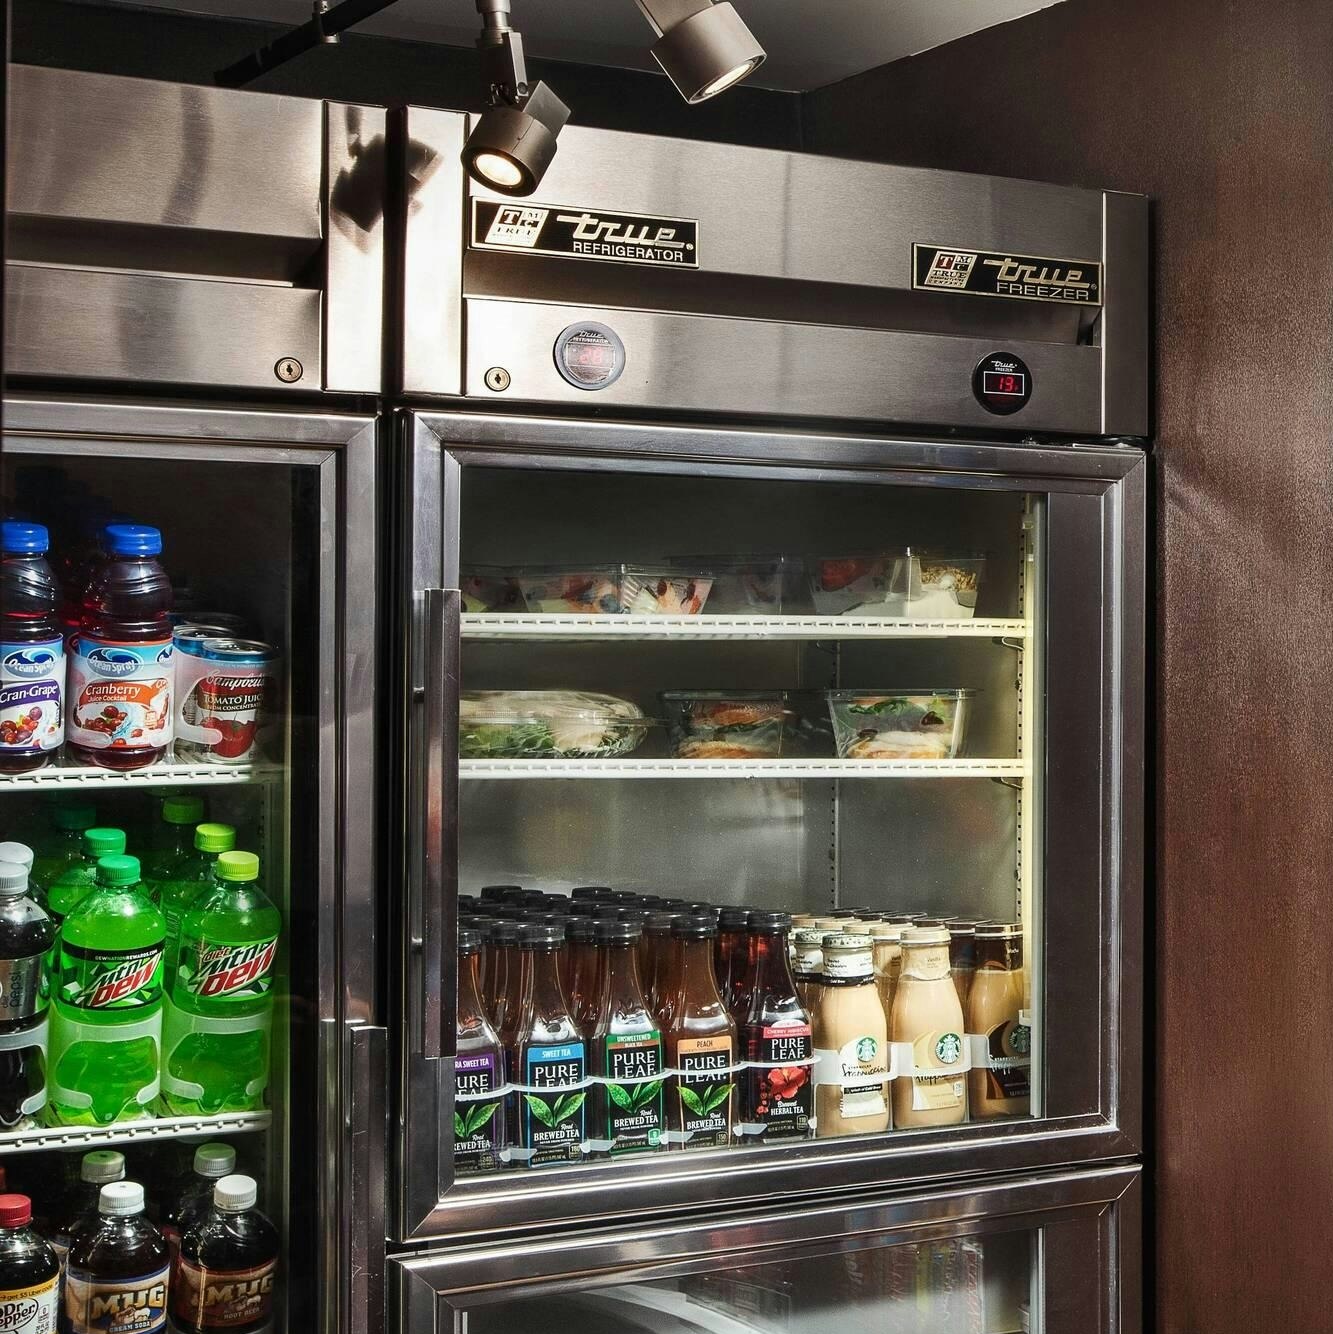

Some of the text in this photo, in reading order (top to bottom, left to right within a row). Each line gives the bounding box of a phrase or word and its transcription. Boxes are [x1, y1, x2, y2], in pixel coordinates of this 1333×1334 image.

[573, 241, 684, 262] REFRIGERATOR
[997, 282, 1089, 301] FREEZER
[8, 658, 55, 674] Ocean Spray
[88, 655, 136, 674] Ocean Spray
[0, 683, 59, 704] Cran-Grape
[85, 682, 142, 699] Cranberry
[102, 694, 128, 702] Cocktail
[204, 694, 242, 705] TOMATO
[616, 1033, 651, 1042] UNSWEETENED
[696, 1040, 713, 1048] PEACH
[771, 1037, 805, 1049] PURE
[542, 1048, 571, 1058] SWEET TEA
[613, 1050, 656, 1067] PURE
[463, 1059, 479, 1068] SWEET
[480, 1057, 490, 1067] TEA
[685, 1055, 726, 1071] PURE
[535, 1063, 579, 1080] PURE
[457, 1073, 489, 1089] URE
[770, 1106, 804, 1116] HERBAL TEA
[614, 1114, 659, 1128] BREWED TEA
[686, 1117, 726, 1130] BREWED TEA
[534, 1129, 580, 1142] BREWED TEA
[477, 1139, 491, 1149] TEA
[206, 1276, 274, 1307] MUG
[97, 1285, 166, 1319] MUG
[224, 1310, 242, 1320] ROOT
[109, 1320, 151, 1333] CREAM SODA
